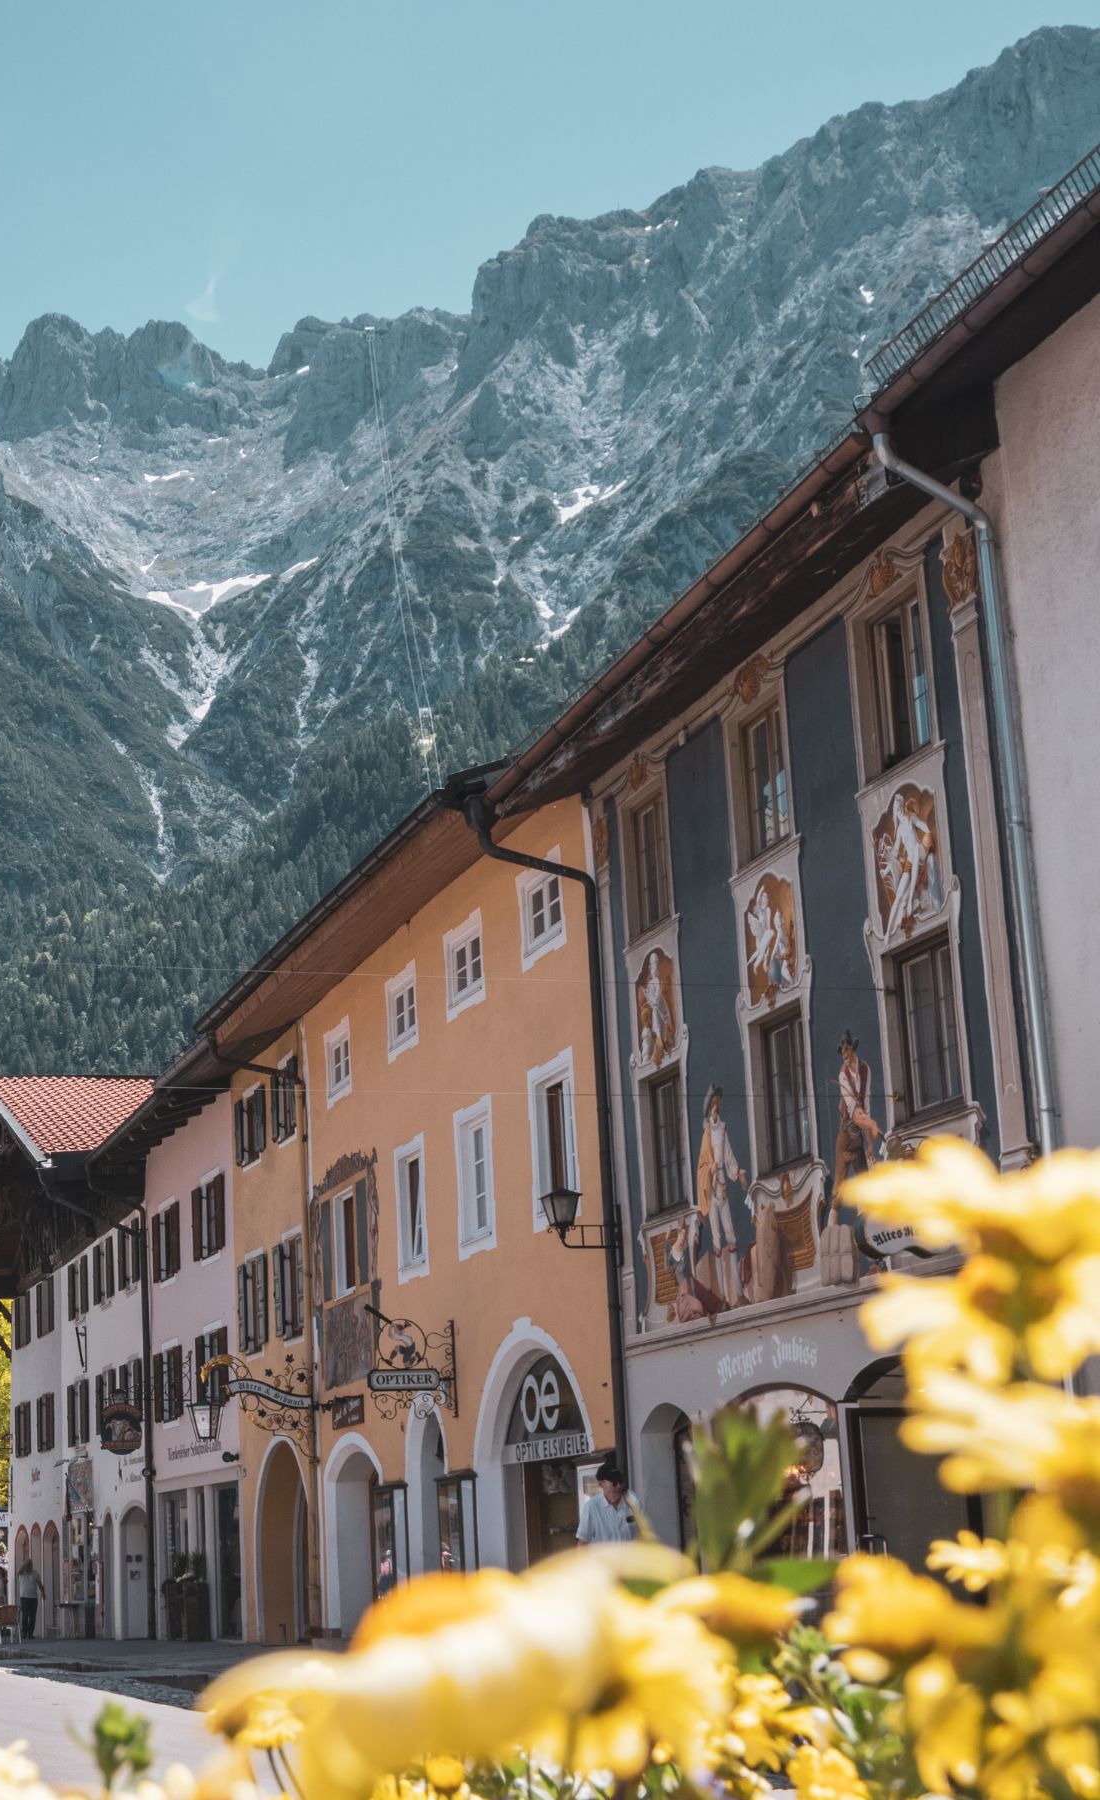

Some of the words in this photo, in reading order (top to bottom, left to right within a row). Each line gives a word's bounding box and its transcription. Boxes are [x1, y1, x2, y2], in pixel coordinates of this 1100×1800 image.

[871, 1228, 903, 1247] Altes
[717, 1344, 764, 1387] Metzger
[376, 1373, 433, 1385] OPTIKER
[238, 1382, 262, 1392] Uhren
[264, 1387, 271, 1395] &
[274, 1392, 305, 1406] Schmuck
[516, 1442, 541, 1461] OPTIK
